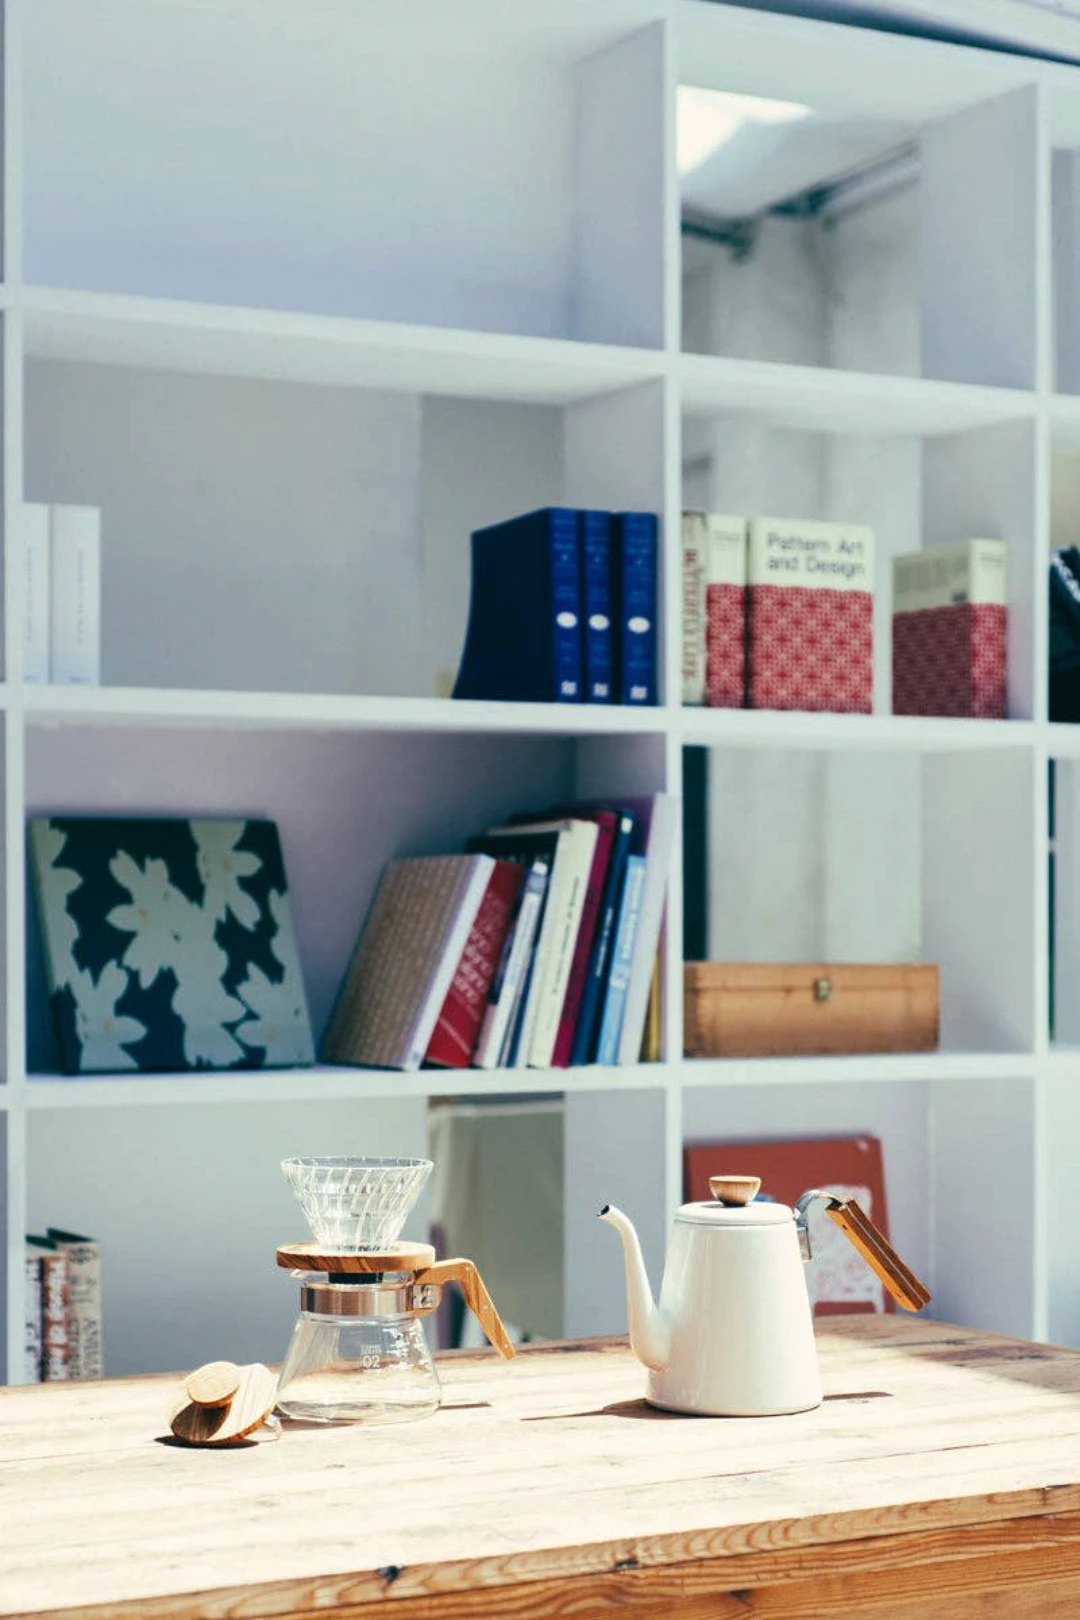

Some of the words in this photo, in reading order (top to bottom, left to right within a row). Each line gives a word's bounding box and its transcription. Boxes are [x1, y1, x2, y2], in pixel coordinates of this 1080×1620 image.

[767, 532, 830, 551] Pattern
[838, 537, 864, 554] Art
[768, 556, 798, 571] and
[806, 557, 865, 579] Design
